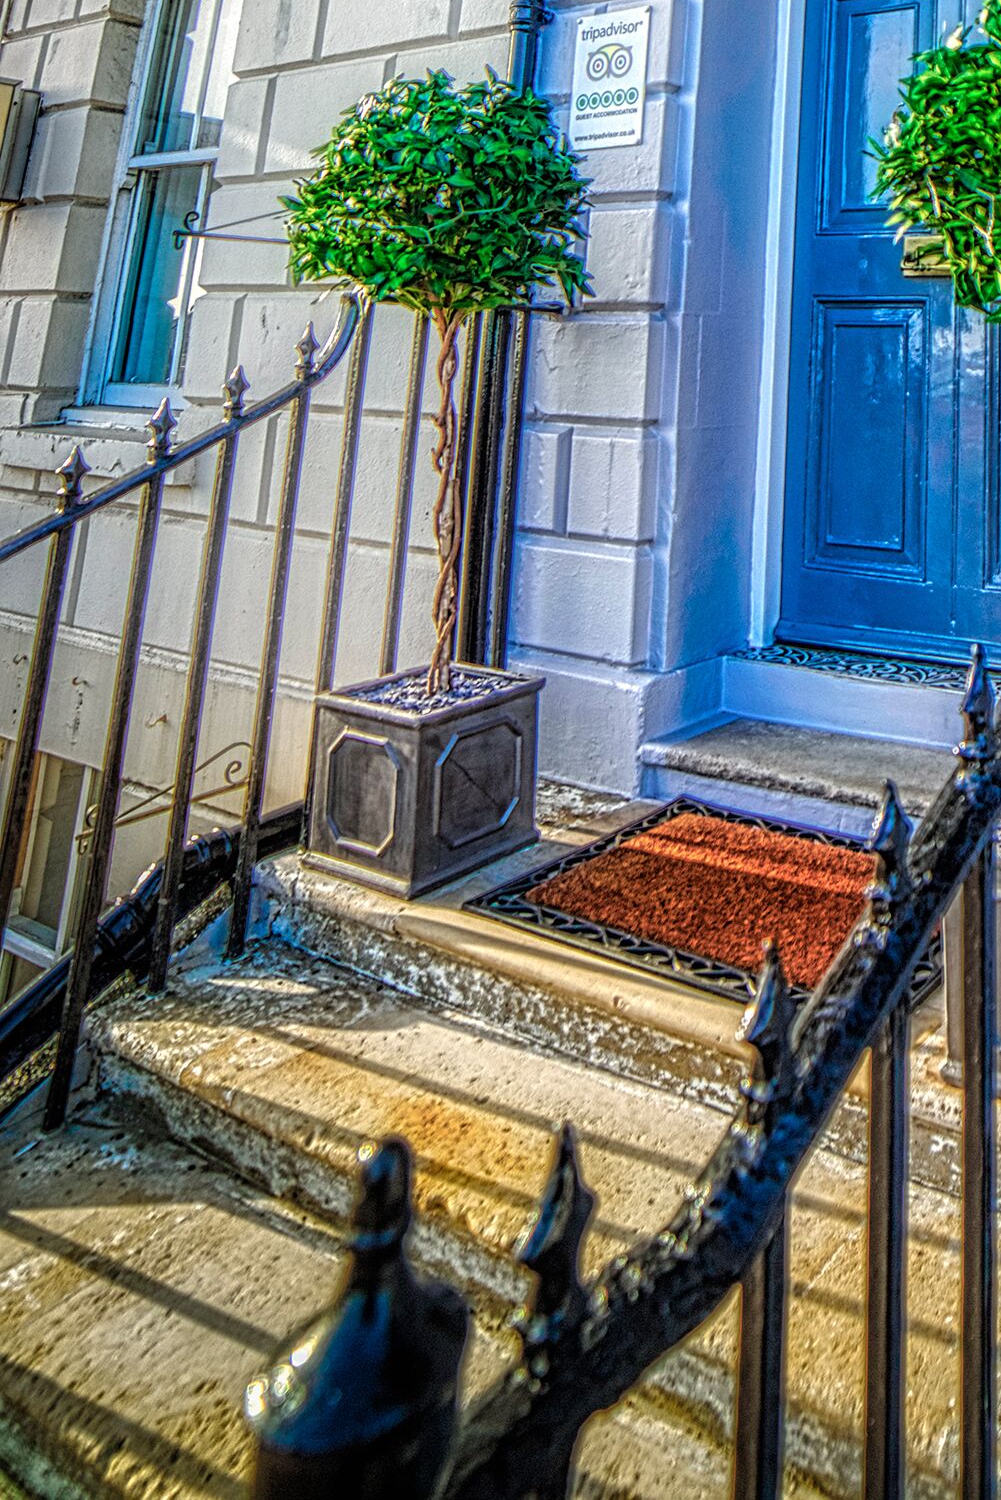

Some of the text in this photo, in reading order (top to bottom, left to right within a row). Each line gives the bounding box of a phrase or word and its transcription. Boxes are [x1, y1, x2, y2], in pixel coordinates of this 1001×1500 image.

[575, 107, 638, 121] GUEST ACCOMMODATION
[574, 128, 635, 142] www.tripadvisor.co.uk
